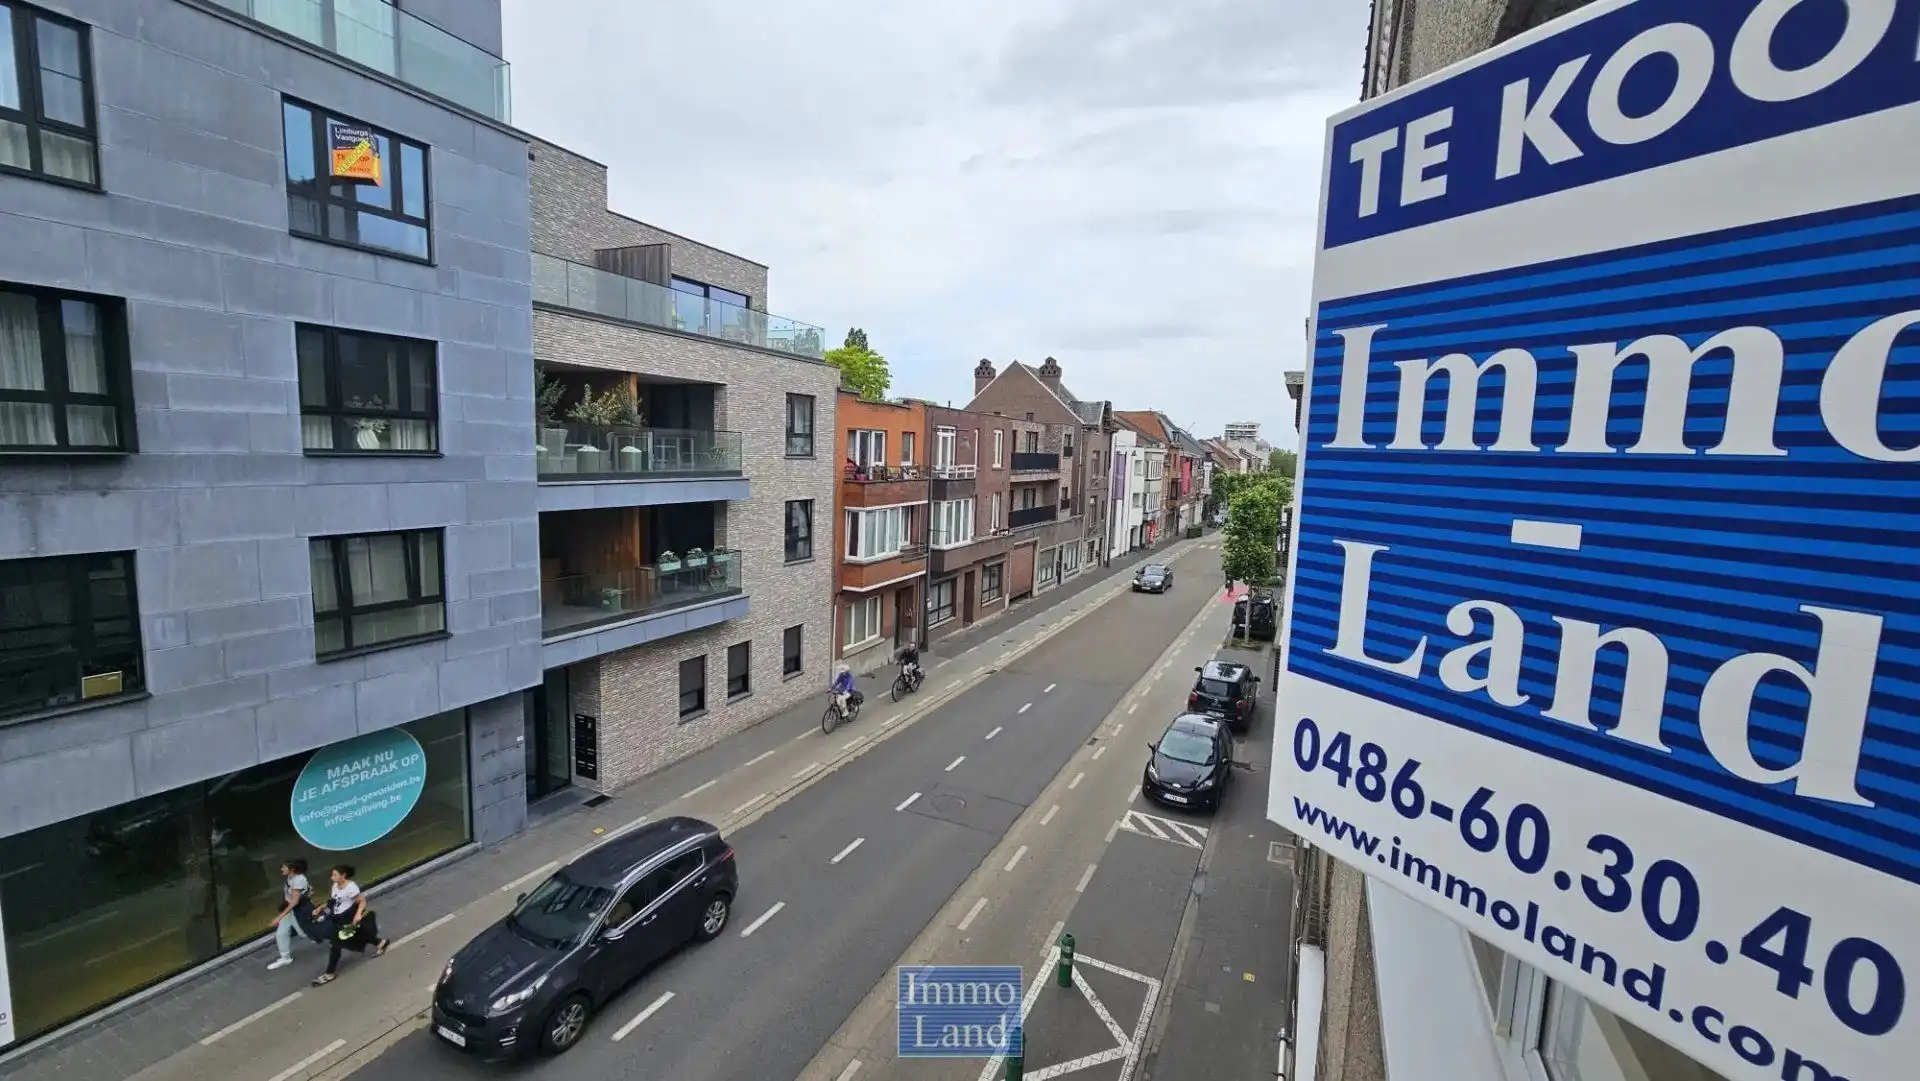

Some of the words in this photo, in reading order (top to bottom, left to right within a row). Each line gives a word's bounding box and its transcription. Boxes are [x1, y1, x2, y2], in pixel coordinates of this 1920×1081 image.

[334, 126, 369, 137] Limburgs
[1349, 105, 1454, 219] TE
[1495, 0, 1920, 181] KOO
[1322, 538, 1885, 808] Land
[298, 786, 317, 803] JE
[321, 760, 399, 796] AFSPRAAK
[401, 753, 420, 767] OP
[327, 756, 371, 781] MAAK
[374, 749, 395, 766] NU
[300, 775, 422, 824] info@goed-gevonden.be
[1293, 717, 1906, 1037] 0486-60.30.40
